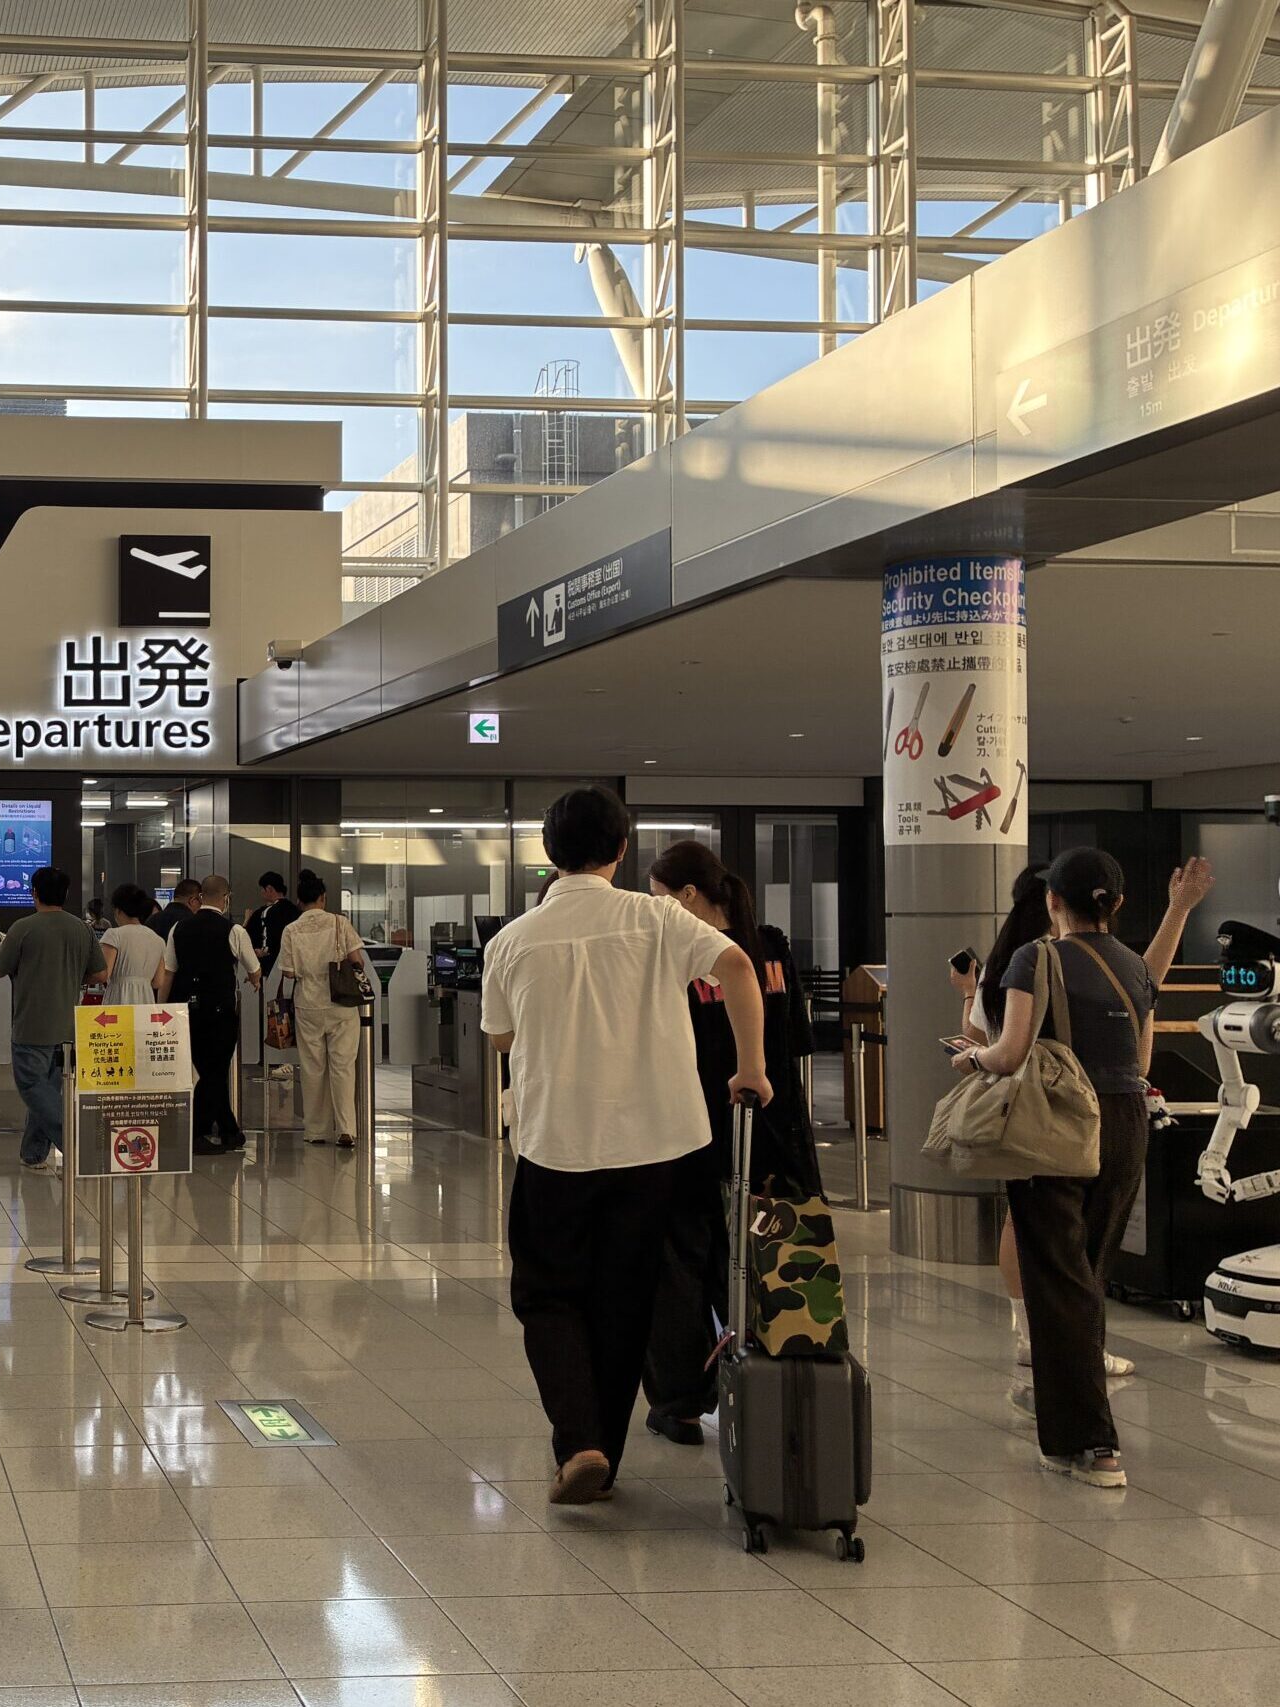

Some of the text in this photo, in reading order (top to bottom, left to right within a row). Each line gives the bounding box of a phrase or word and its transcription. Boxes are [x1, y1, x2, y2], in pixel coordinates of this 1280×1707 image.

[1126, 312, 1181, 369] 出発
[1126, 370, 1153, 399] 출발
[1140, 400, 1162, 417] 15m
[884, 562, 961, 590] Prohibited
[970, 561, 1014, 581] Items
[567, 596, 586, 610] Customs
[586, 590, 601, 602] Office
[882, 591, 934, 616] Security
[896, 632, 947, 650] 검색대에
[955, 630, 983, 645] 반입
[63, 636, 210, 709] 出発
[898, 814, 919, 823] Tools
[1239, 968, 1256, 985] to
[89, 1032, 122, 1040] 優先レーン
